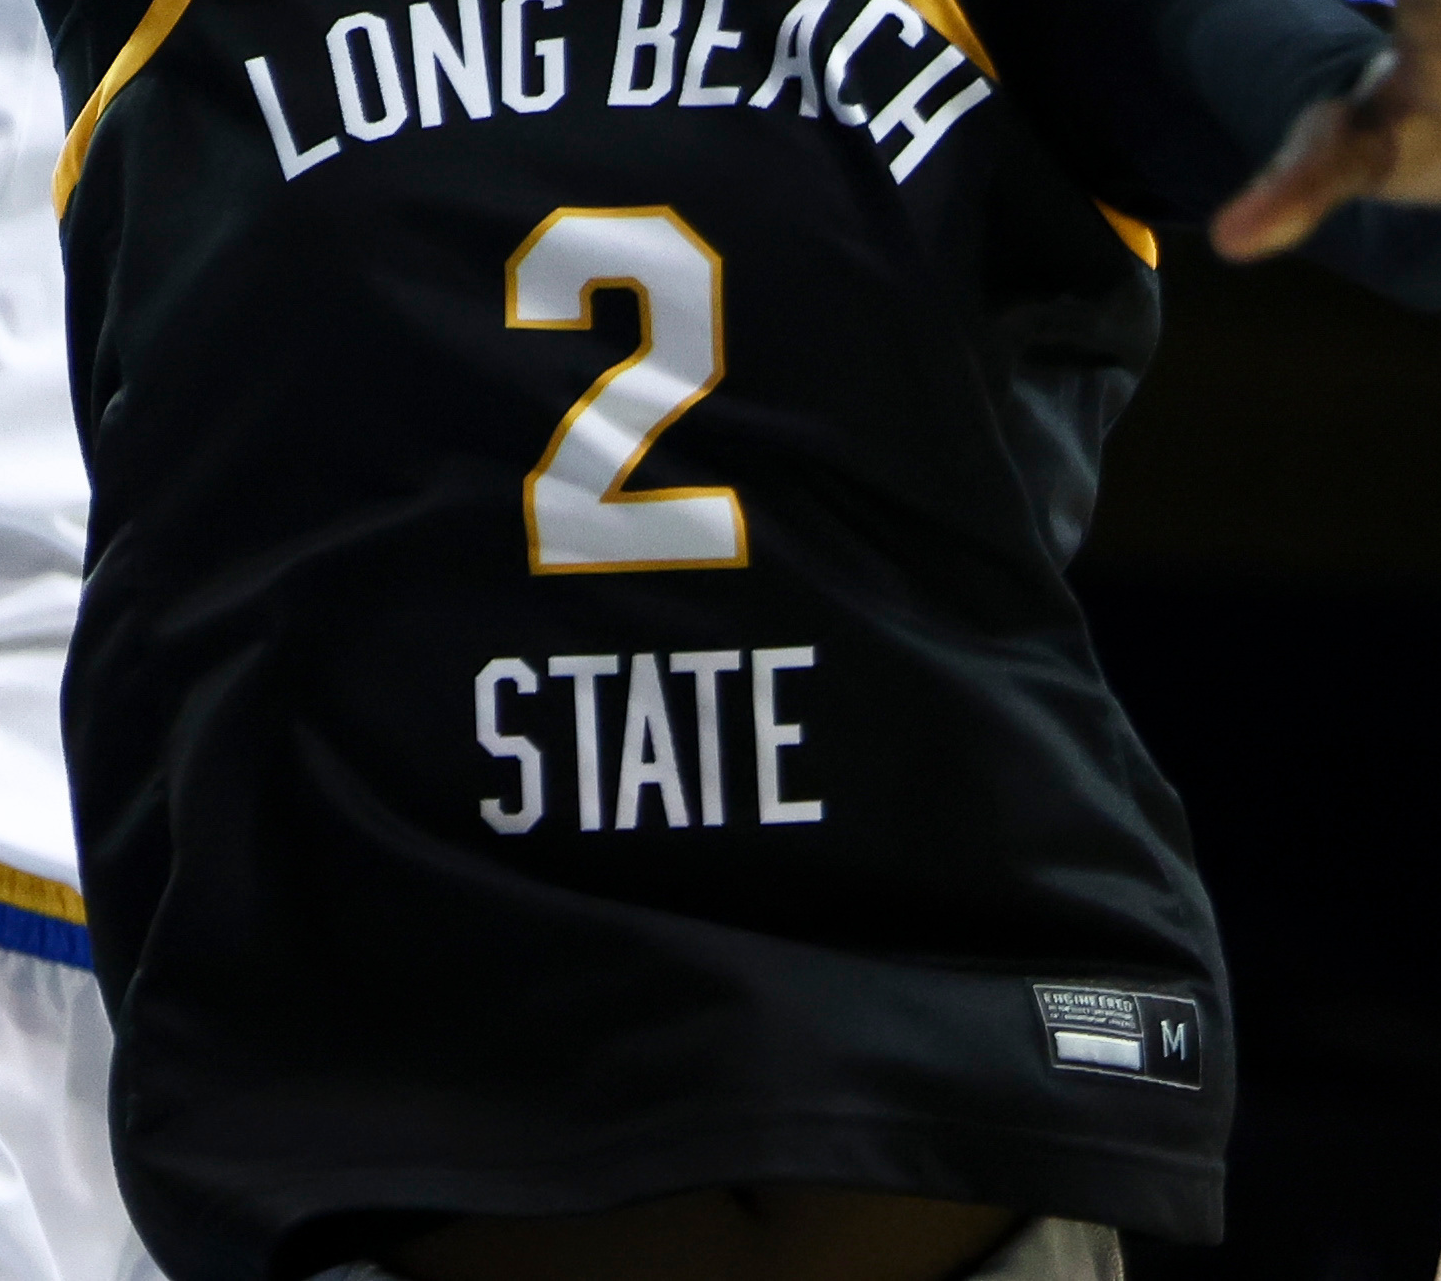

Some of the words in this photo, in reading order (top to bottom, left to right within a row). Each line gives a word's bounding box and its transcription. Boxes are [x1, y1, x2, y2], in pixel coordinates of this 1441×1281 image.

[505, 205, 748, 574] 2
[474, 646, 824, 835] STATE
[1160, 1019, 1186, 1061] M
